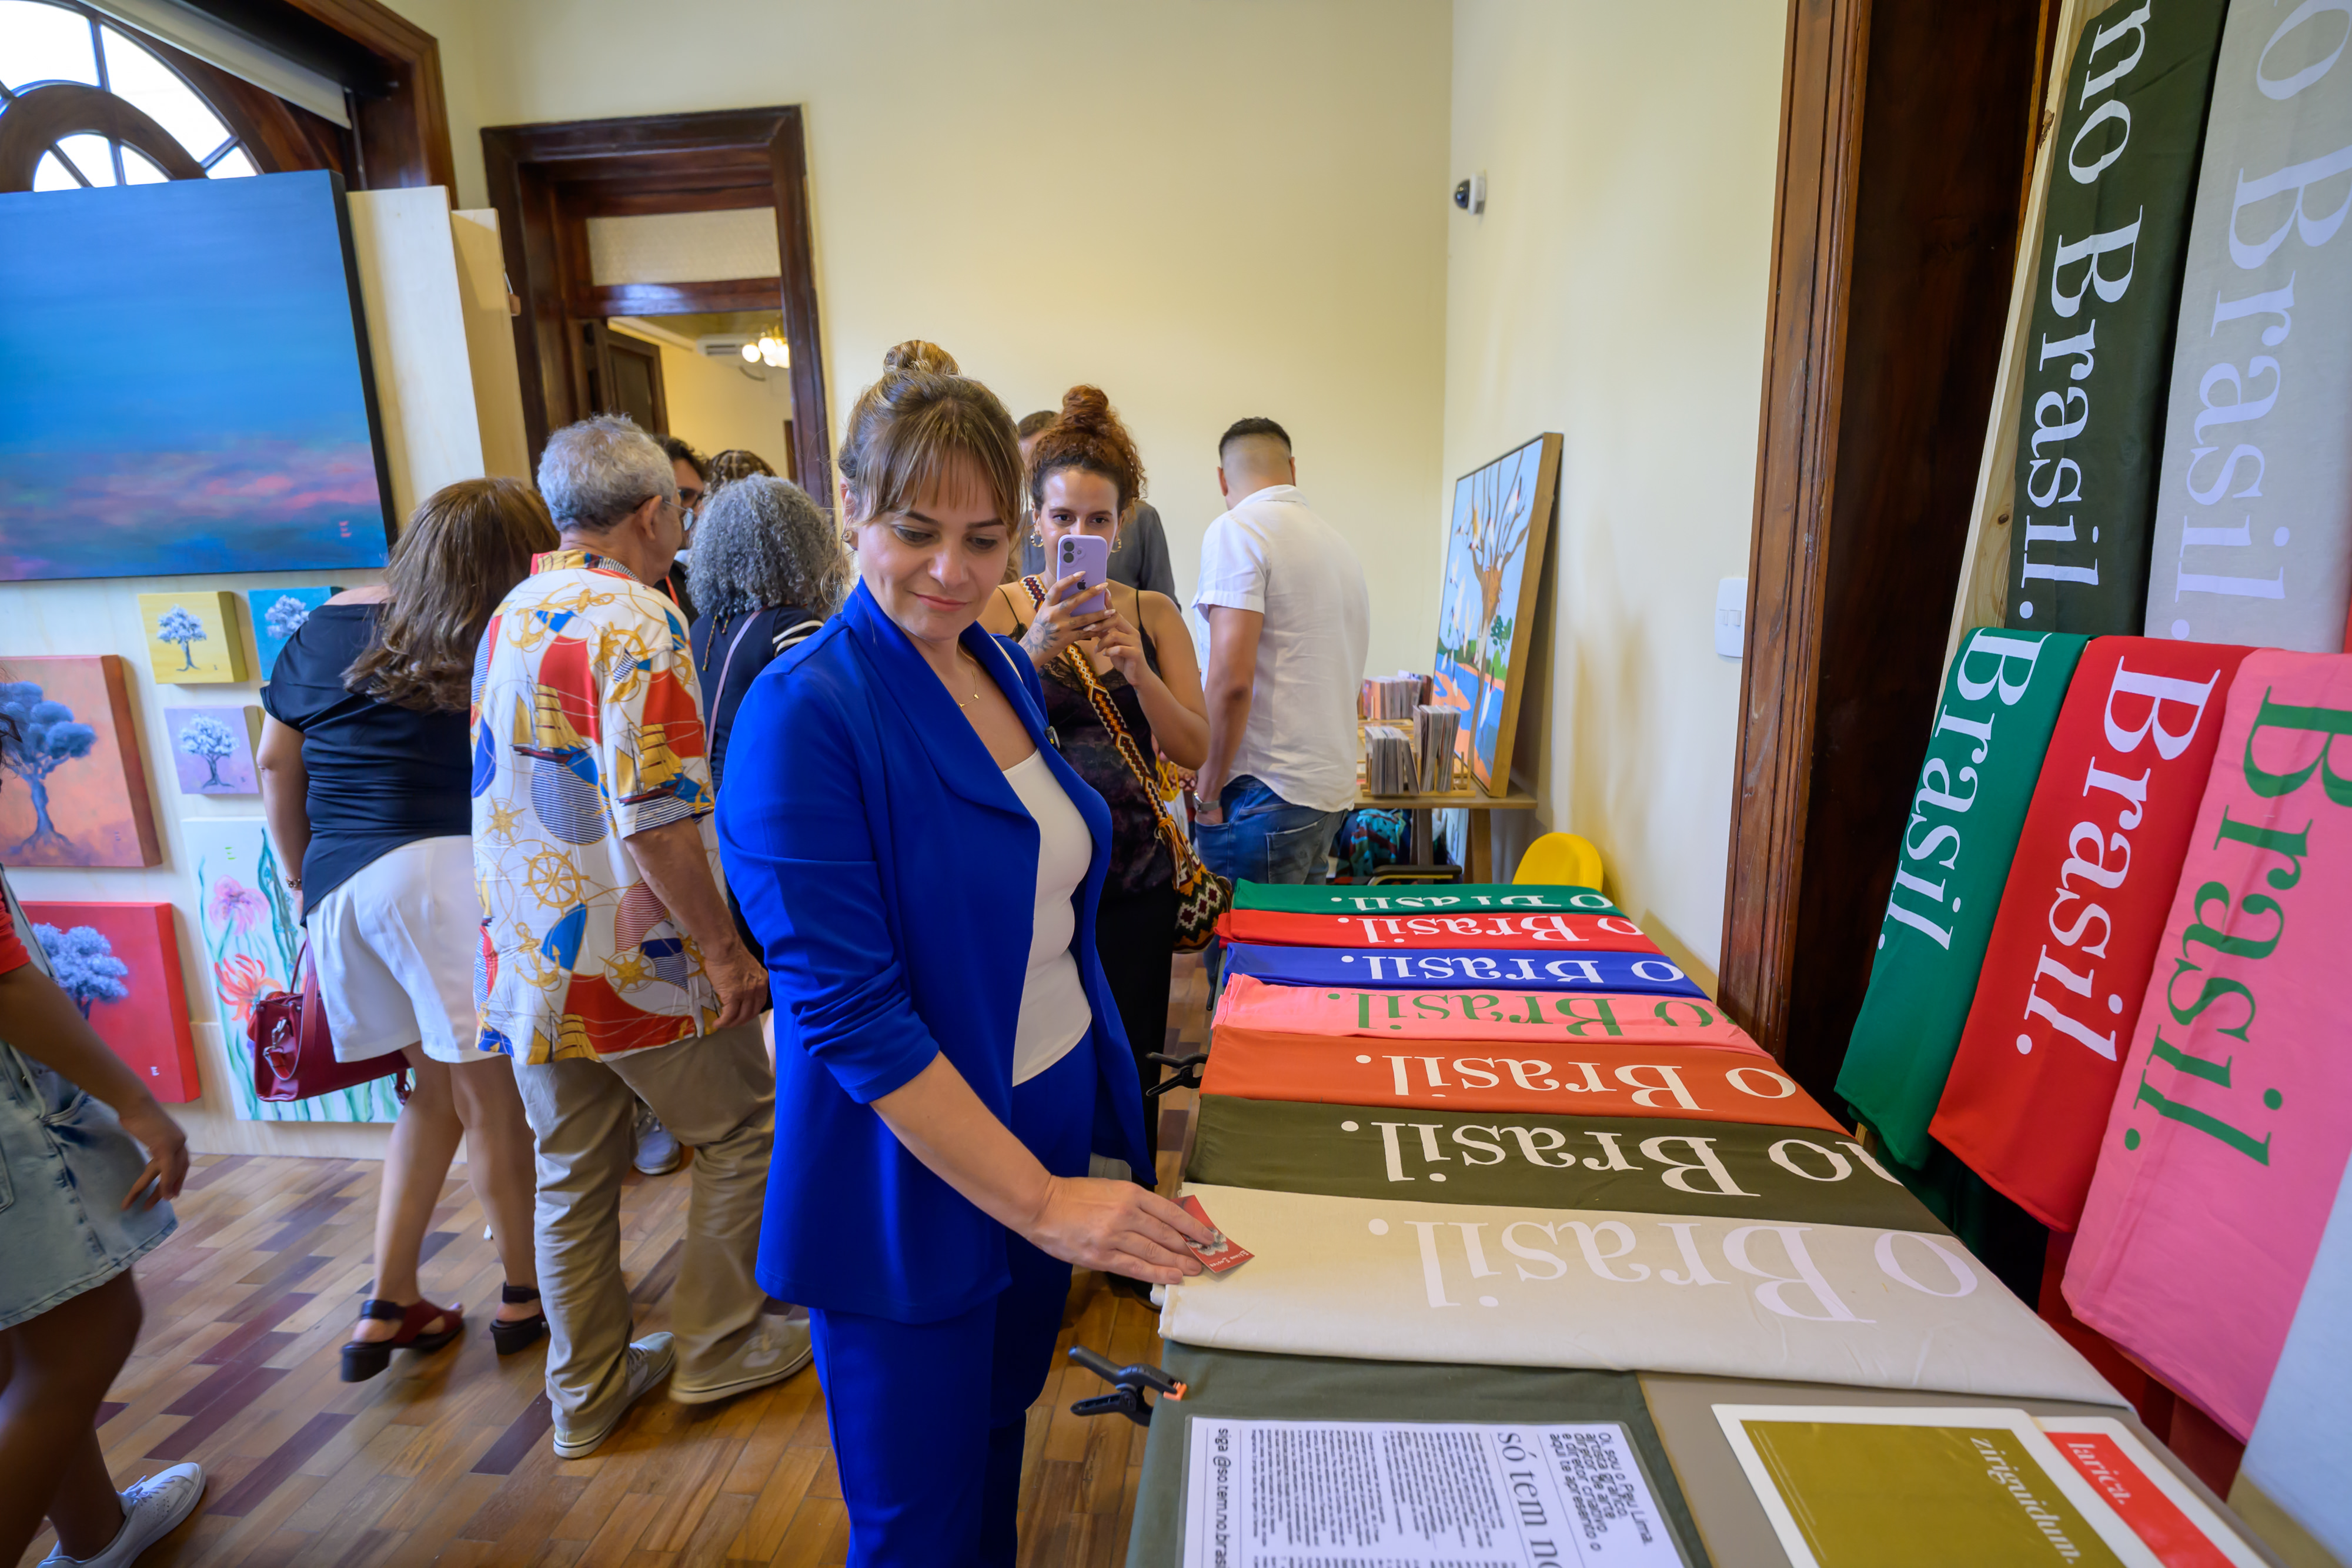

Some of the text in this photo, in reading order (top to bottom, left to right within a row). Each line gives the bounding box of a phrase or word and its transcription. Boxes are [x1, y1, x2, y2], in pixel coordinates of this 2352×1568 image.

[2171, 0, 2352, 640] o Brasil.
[2019, 205, 2142, 619] Brasil.
[1878, 627, 2053, 950] Brasil.
[2017, 656, 2220, 1062] Brasil.
[1338, 915, 1589, 944] Brasil.
[1341, 955, 1605, 984] Brasil.
[2124, 686, 2352, 1166] Brasil.
[1327, 992, 1623, 1037] Brasil.
[1355, 1054, 1713, 1111] Brasil.
[1341, 1120, 1761, 1198] Brasil.
[1368, 1218, 1877, 1325] Brasil.
[1215, 1427, 1231, 1452] siga
[1573, 1433, 1615, 1519] diretor de arte
[1586, 1433, 1608, 1469] artista
[2066, 1442, 2132, 1505] larica.
[1497, 1432, 1562, 1568] só tem n
[1549, 1433, 1602, 1551] aqui te apresento o
[1566, 1443, 1589, 1482] diretor
[1582, 1486, 1608, 1532] criativo
[1970, 1437, 2080, 1564] ziriguidum.
